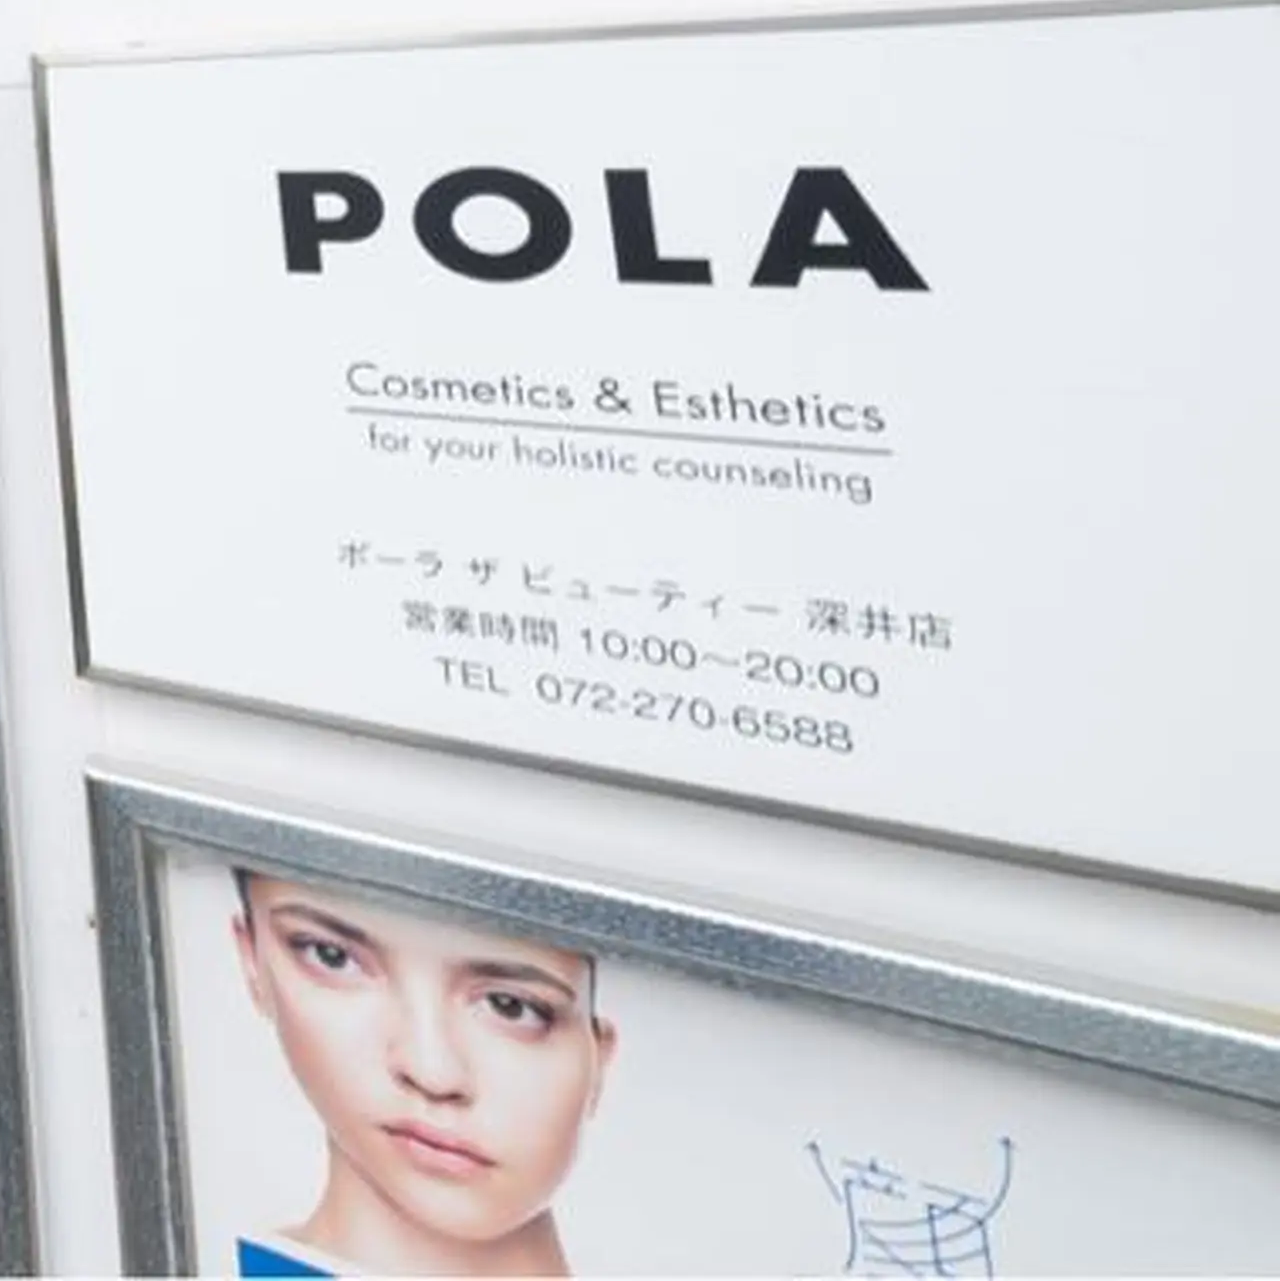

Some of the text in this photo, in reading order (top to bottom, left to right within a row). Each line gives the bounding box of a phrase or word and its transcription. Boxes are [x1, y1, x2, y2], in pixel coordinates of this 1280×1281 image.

[276, 165, 932, 293] POLA
[345, 360, 887, 433] Cosmetics & Esthetics
[366, 421, 874, 506] for your holistic counseling
[401, 599, 559, 656] 営業時間
[805, 596, 954, 651] 深井店
[433, 655, 855, 755] TEL 072-270-6588
